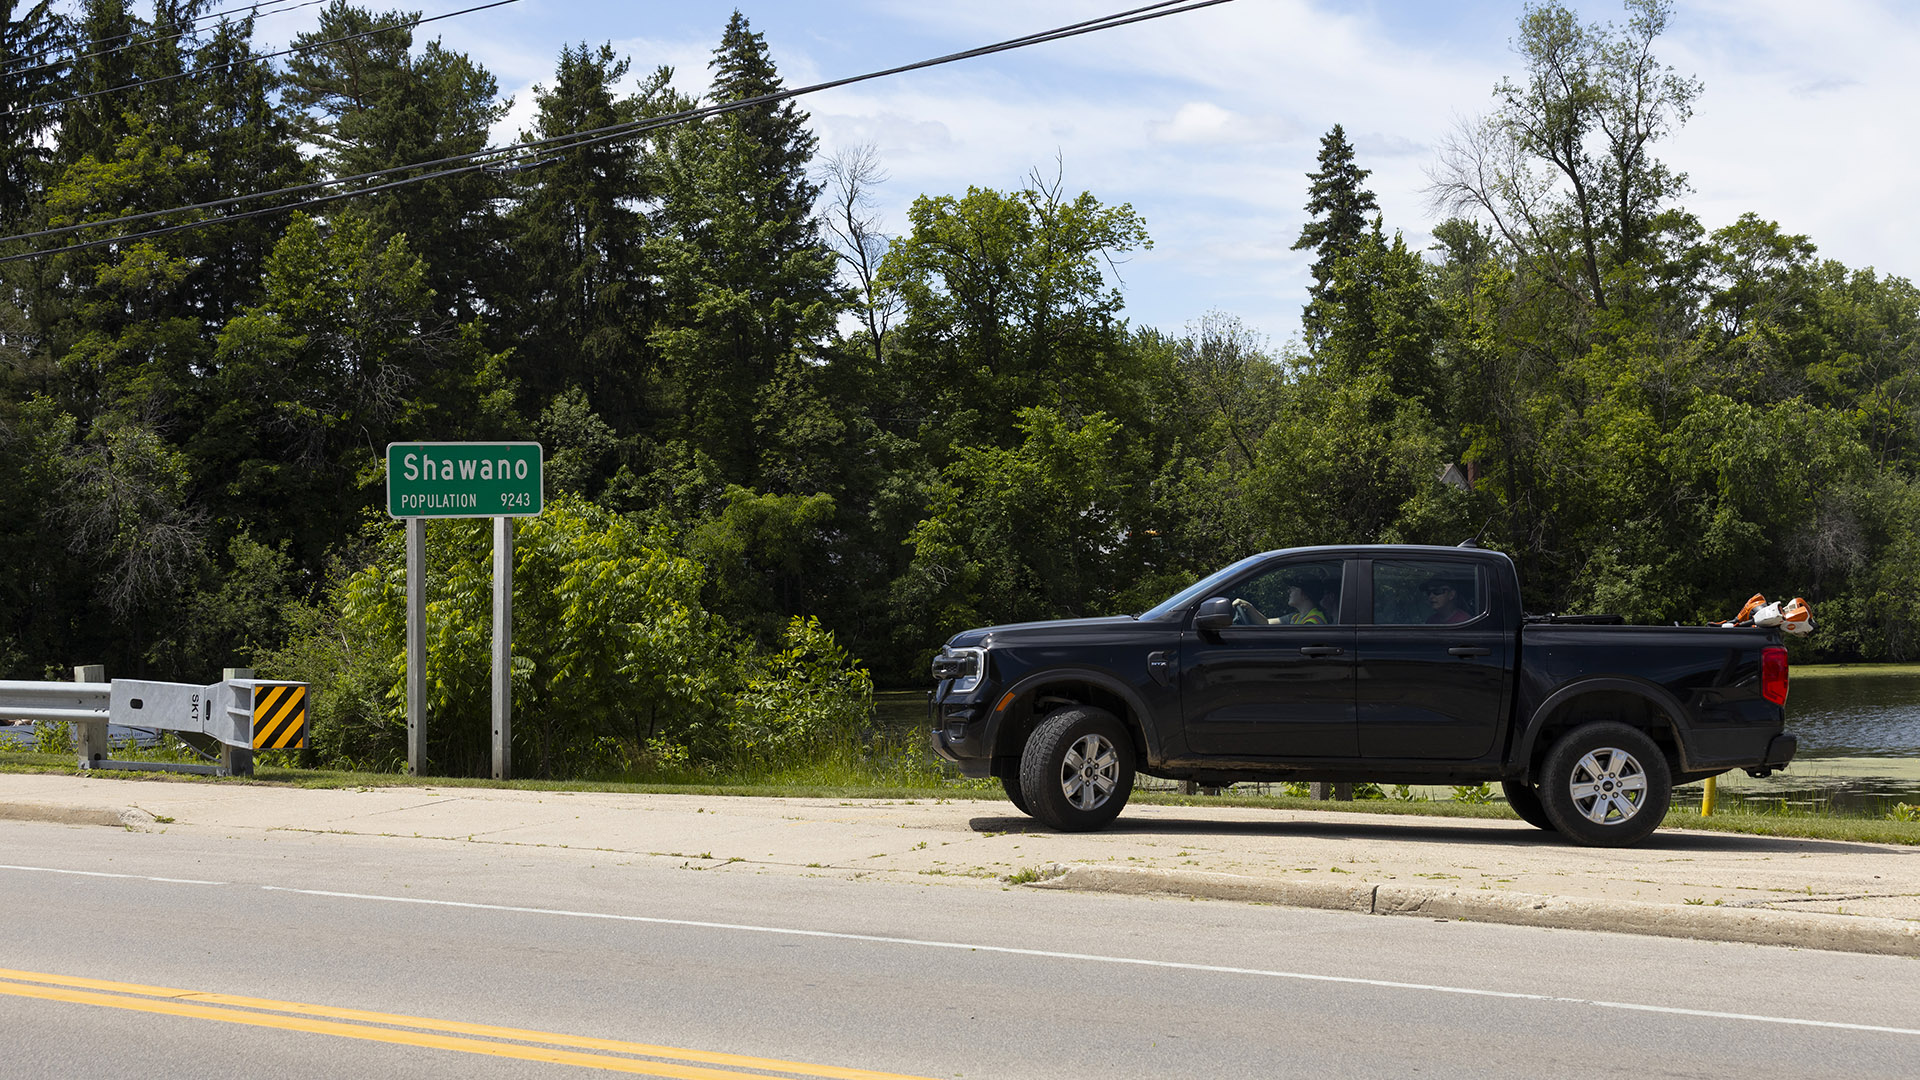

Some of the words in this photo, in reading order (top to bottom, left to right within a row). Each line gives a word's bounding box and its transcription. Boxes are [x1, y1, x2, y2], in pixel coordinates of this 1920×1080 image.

[403, 453, 528, 481] Shawano
[401, 493, 477, 508] POPULATION
[500, 492, 530, 507] 9243
[191, 694, 199, 722] SKT
